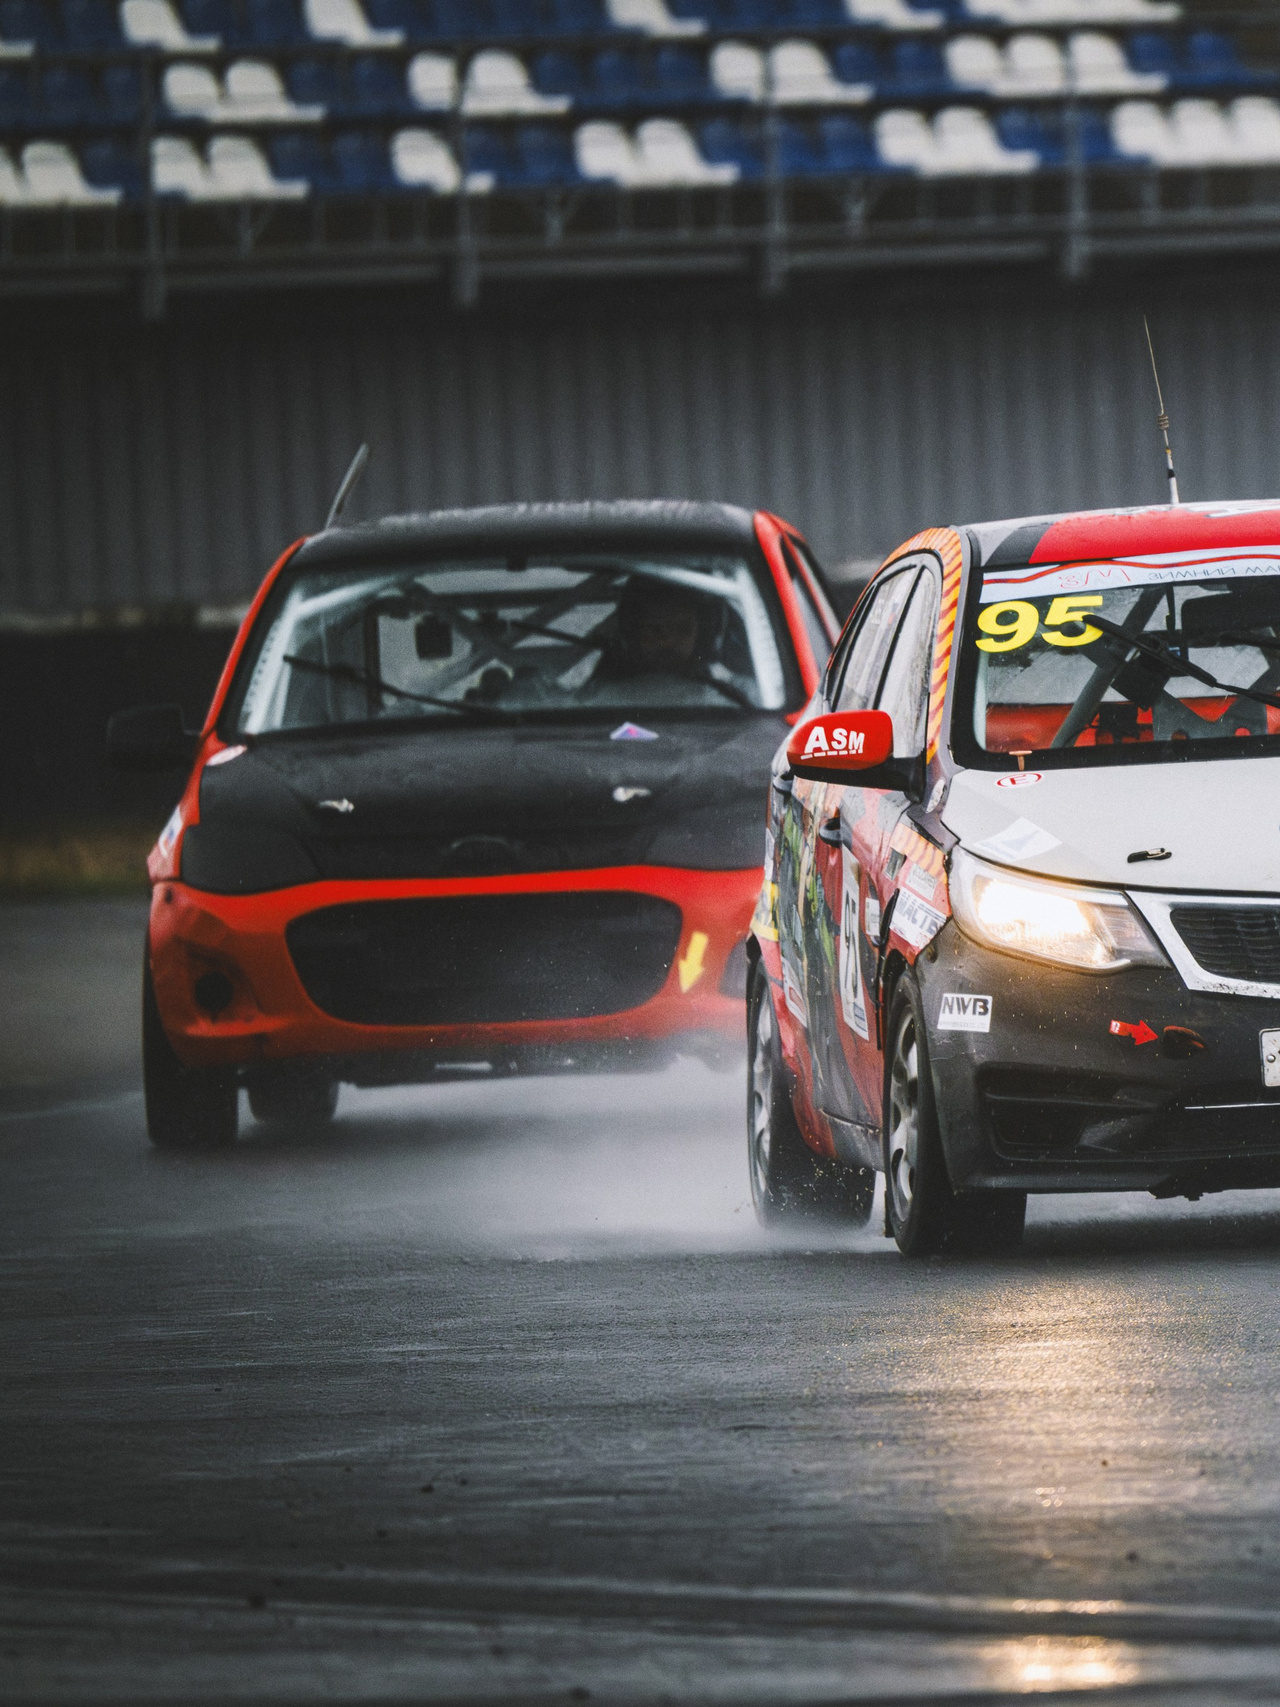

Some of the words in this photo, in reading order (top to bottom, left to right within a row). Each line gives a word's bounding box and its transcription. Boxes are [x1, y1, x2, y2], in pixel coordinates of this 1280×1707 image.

[1148, 565, 1236, 581] ЗИМНИЙ
[975, 595, 1103, 653] 95
[804, 726, 865, 753] ASM
[941, 996, 989, 1016] NWB
